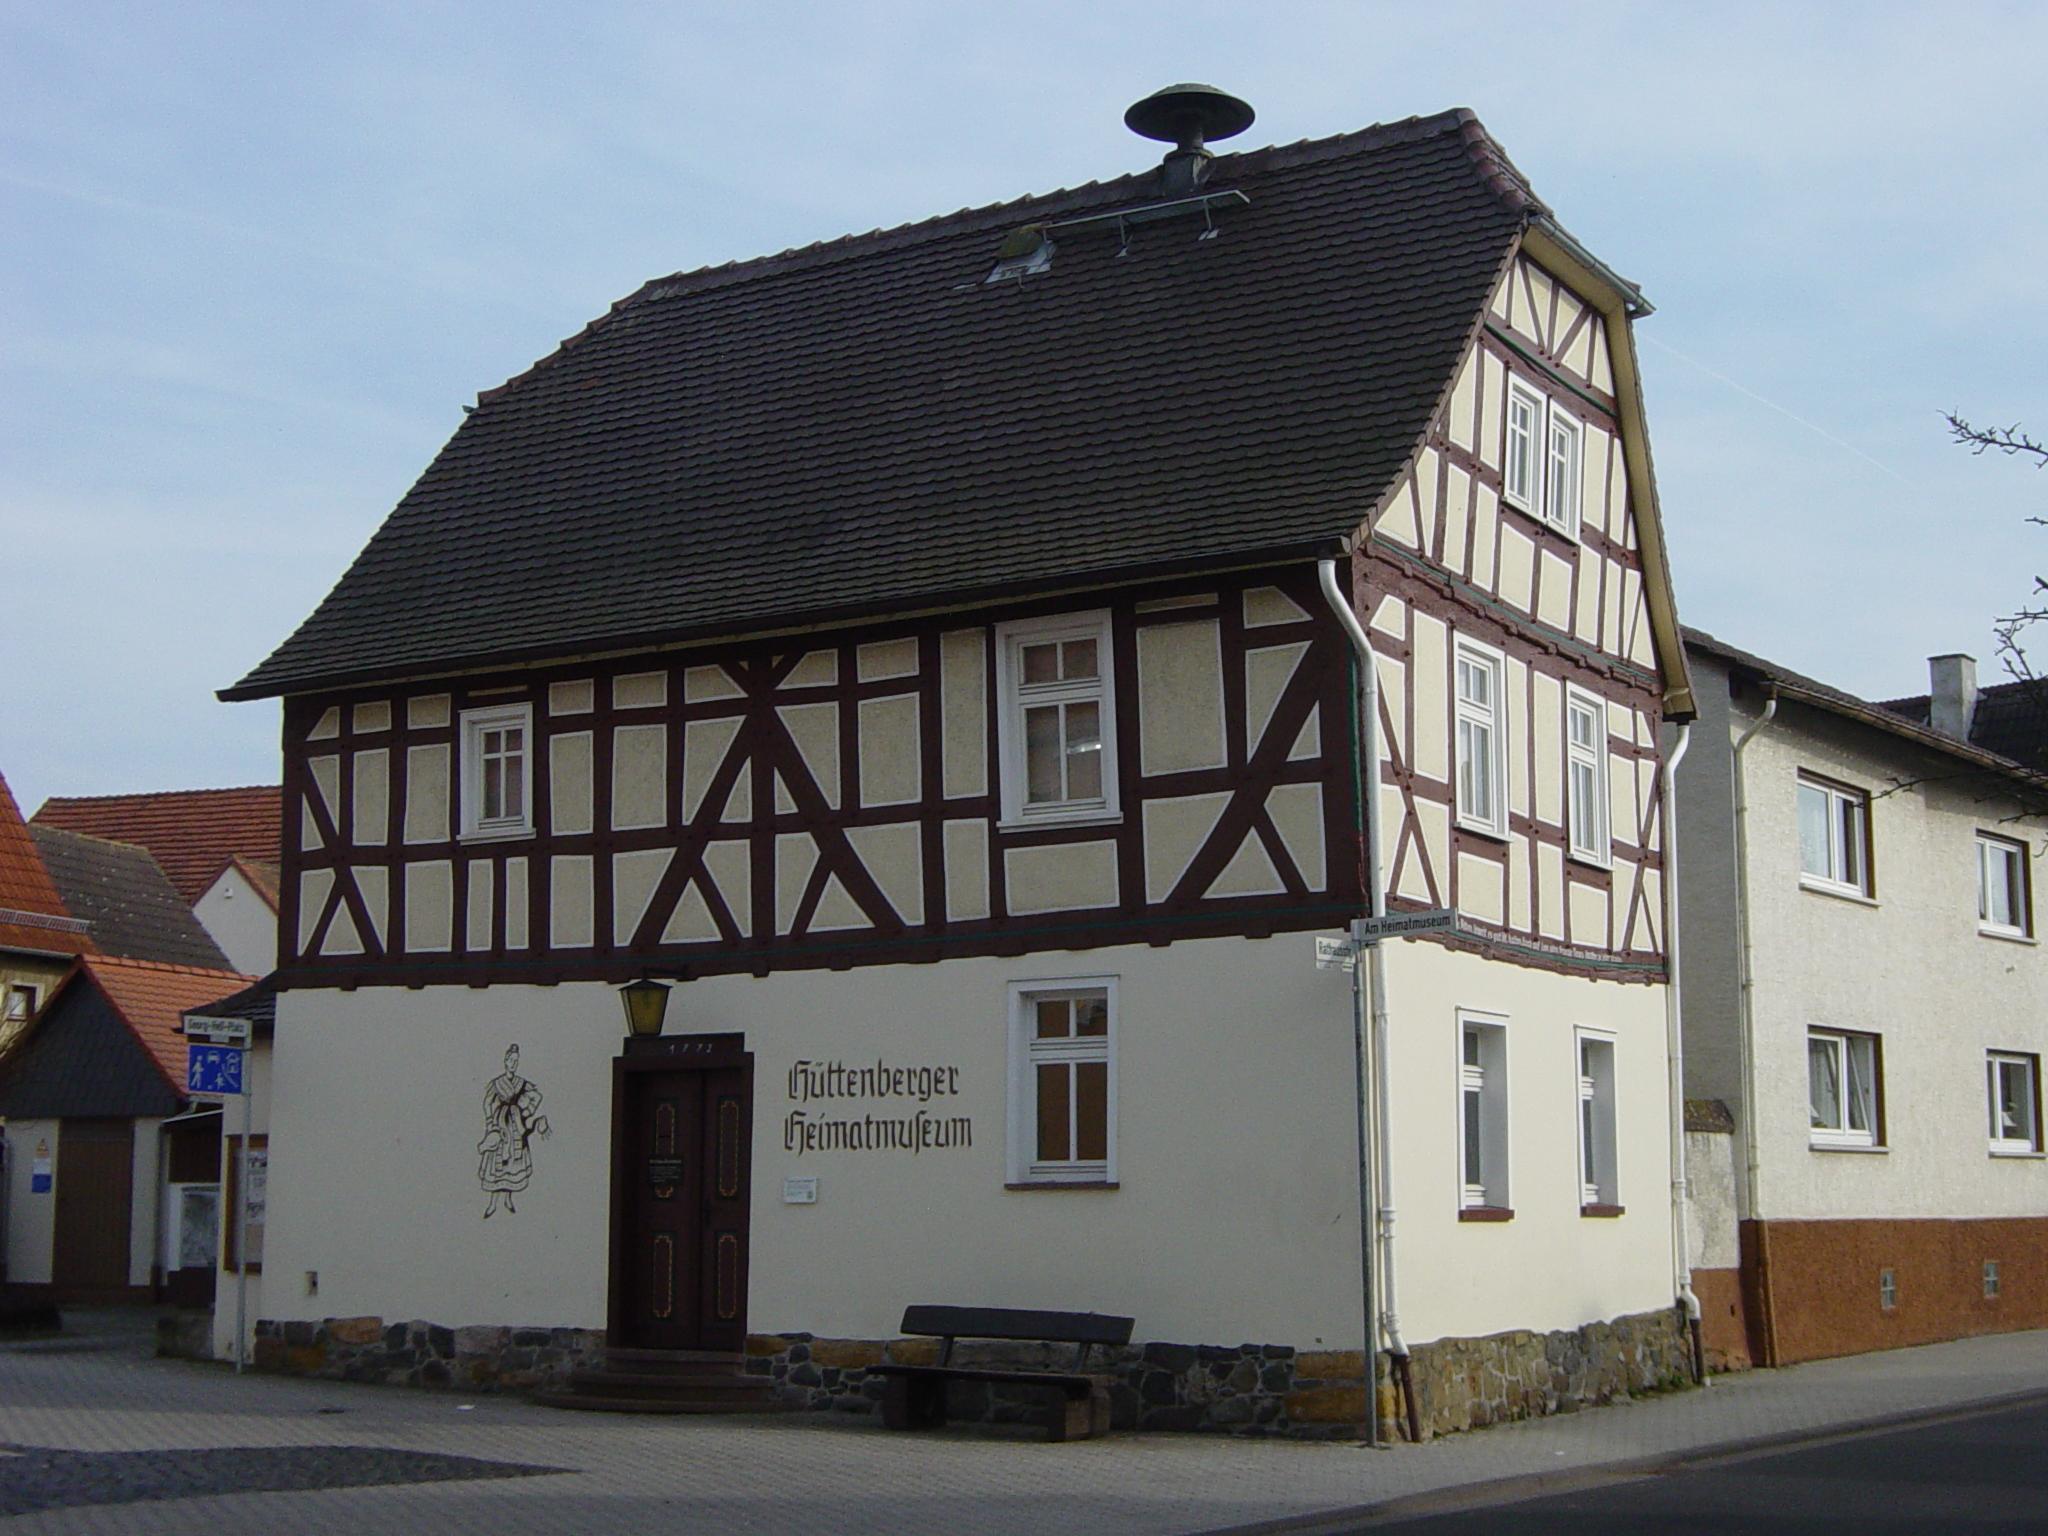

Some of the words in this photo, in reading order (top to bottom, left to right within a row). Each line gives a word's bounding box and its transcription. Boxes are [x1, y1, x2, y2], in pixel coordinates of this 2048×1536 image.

[1365, 922, 1379, 935] Am
[1381, 916, 1451, 932] Heimatmuseum
[788, 1058, 959, 1103] Hüttenberger
